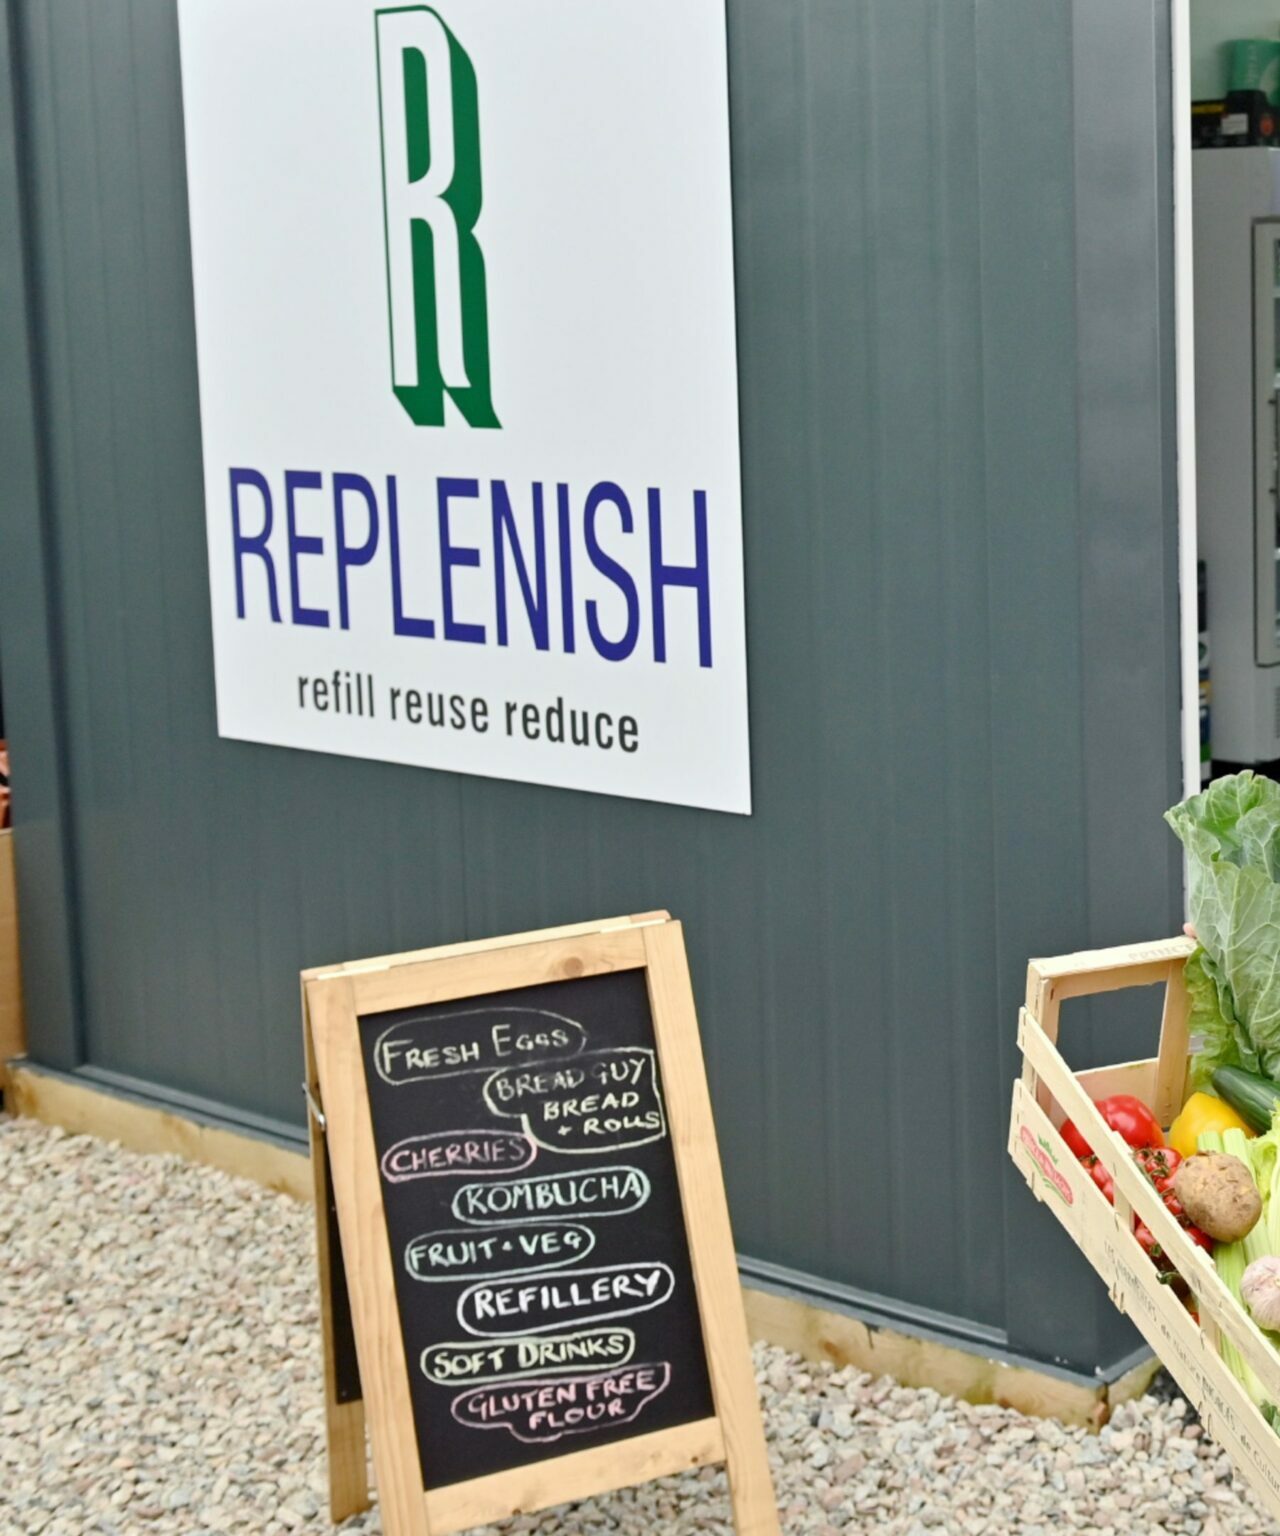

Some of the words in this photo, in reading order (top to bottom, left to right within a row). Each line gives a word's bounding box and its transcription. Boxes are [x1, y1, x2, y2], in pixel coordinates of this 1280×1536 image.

[374, 5, 503, 430] R
[228, 466, 713, 669] REPLENISH
[297, 669, 375, 718] refill
[389, 685, 489, 733] reuse
[504, 696, 640, 754] reduce
[382, 1037, 480, 1074] FRESH
[495, 1067, 585, 1102] BREAD
[543, 1090, 640, 1122] BREAD
[389, 1138, 526, 1173] CHERRIES
[465, 1172, 644, 1215] KOMBUCHA
[409, 1236, 498, 1272] FRUIT
[518, 1231, 583, 1256] VEG
[473, 1269, 662, 1320] REFILLERY
[432, 1348, 506, 1379] SOFT
[517, 1333, 626, 1368] DRINKS
[466, 1381, 577, 1421] GLUTEN
[585, 1369, 656, 1401] FREE
[528, 1398, 627, 1430] FLOUR
